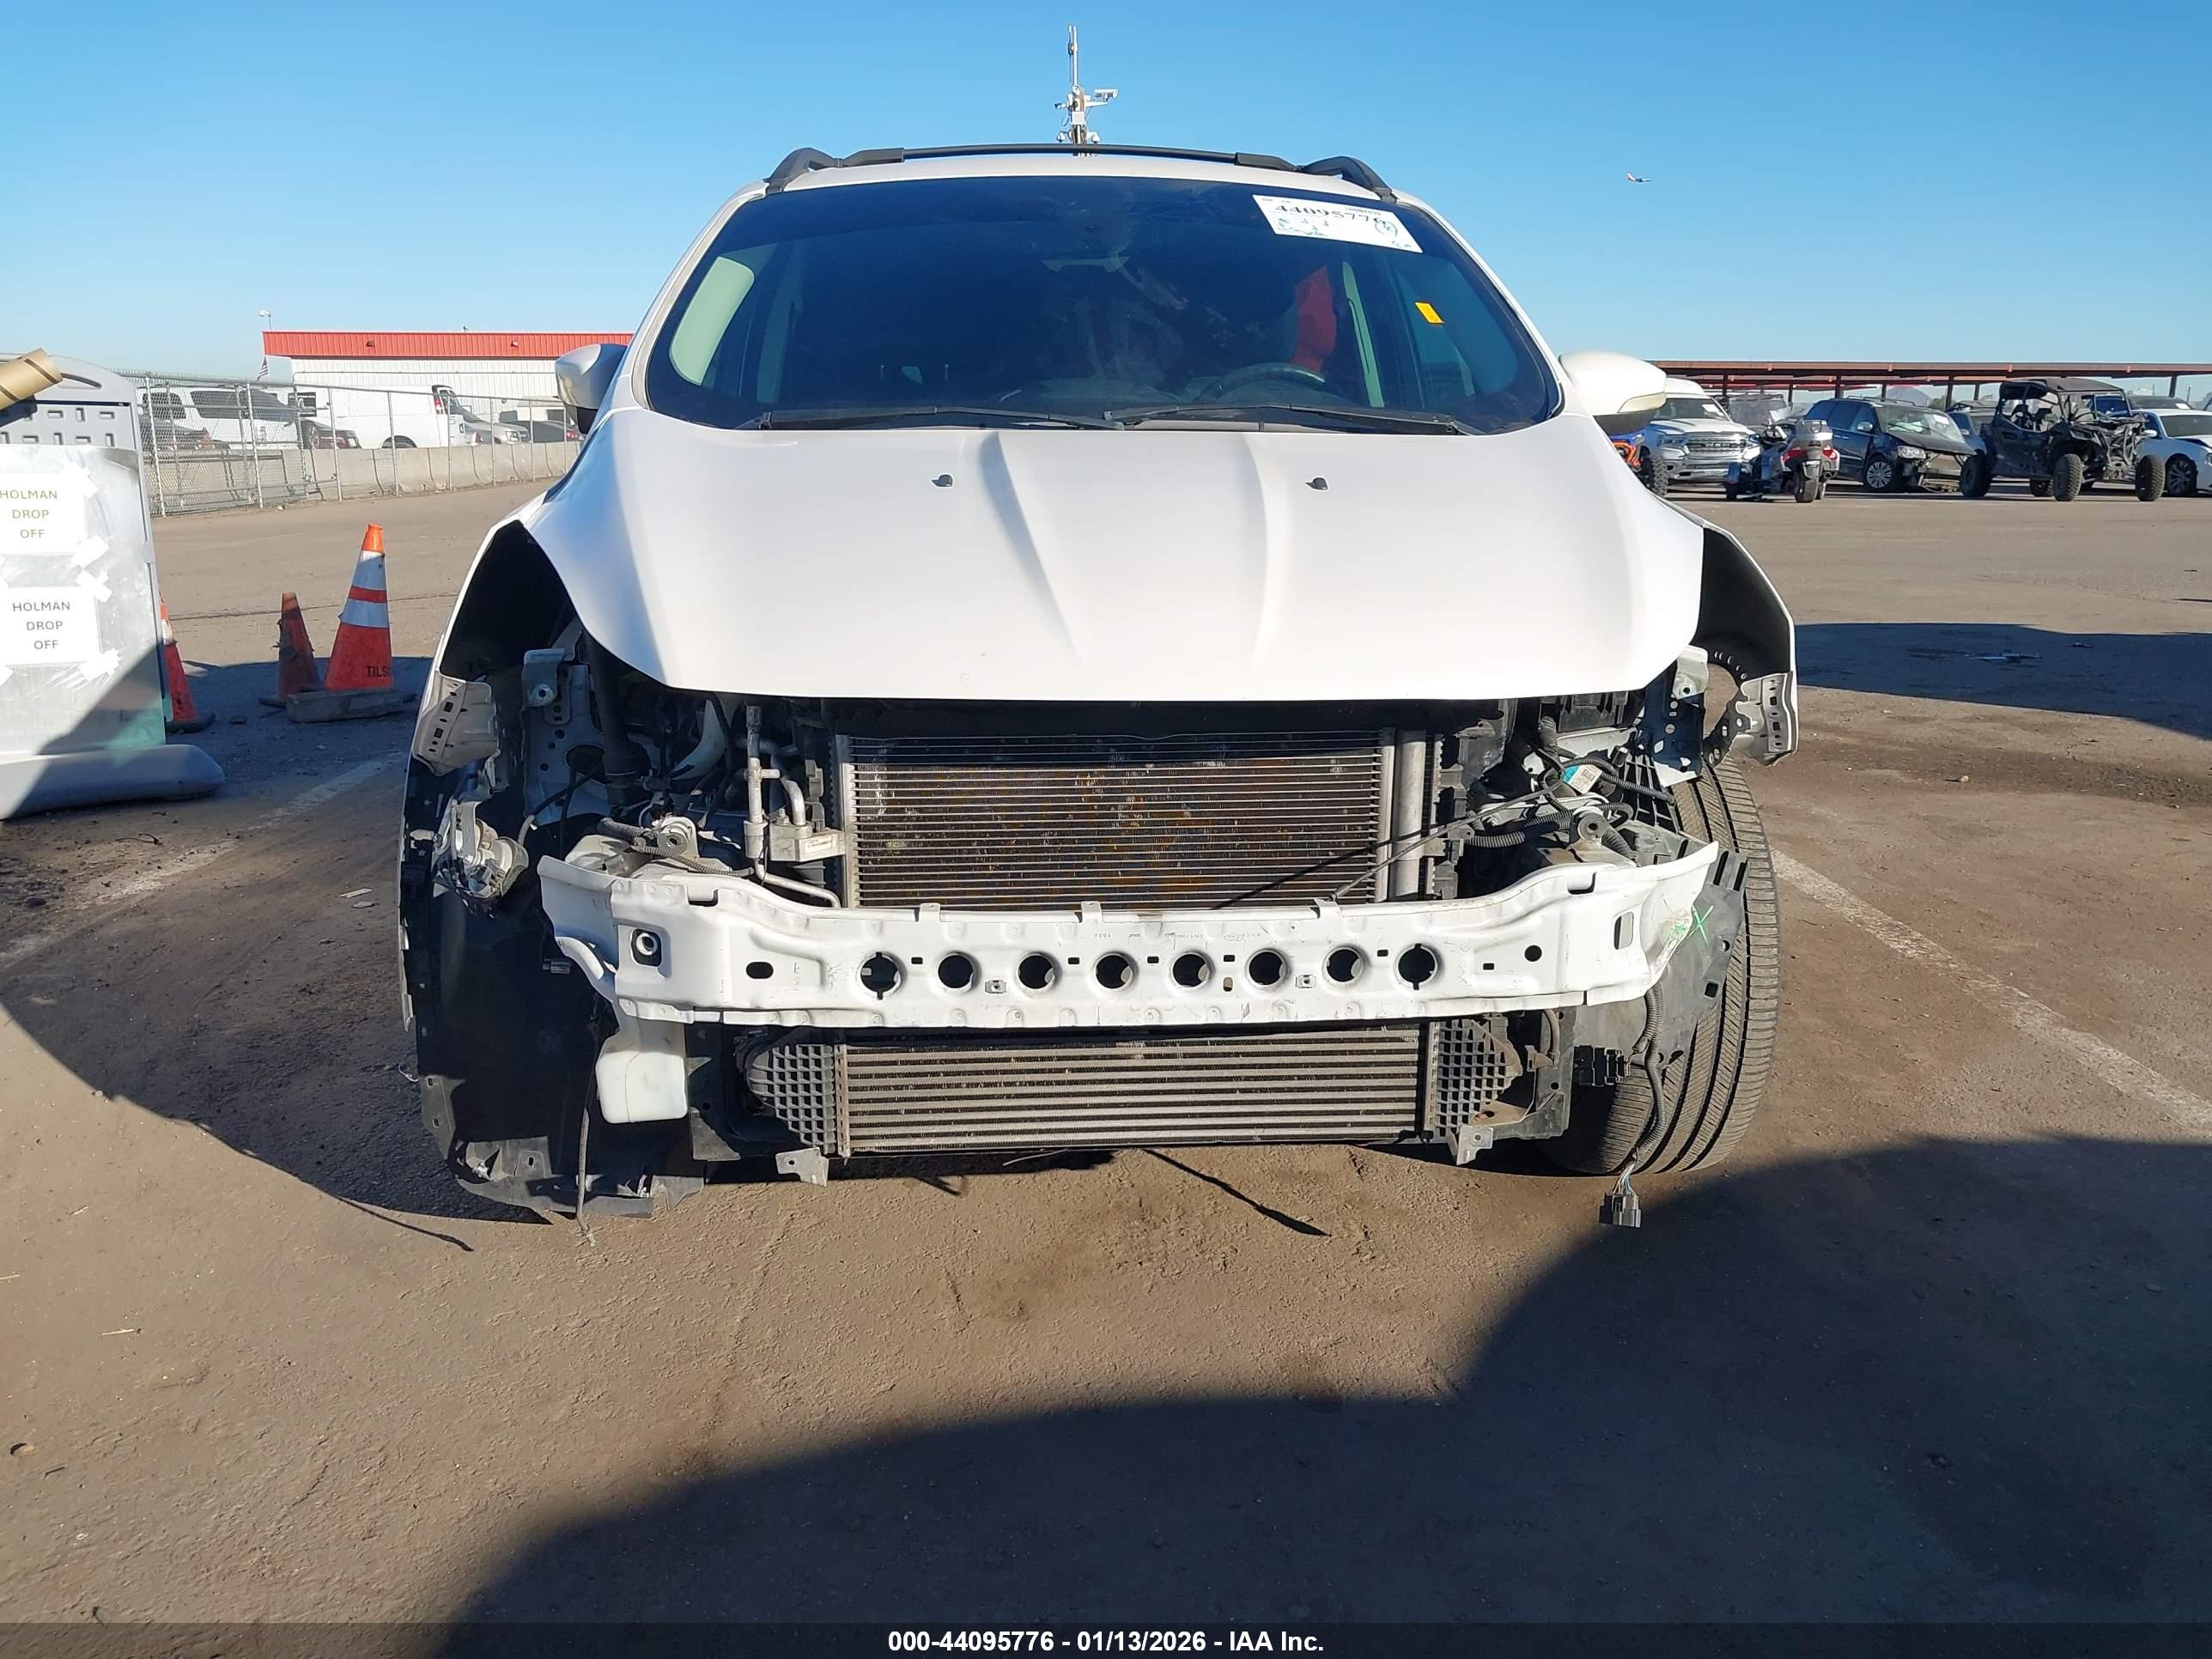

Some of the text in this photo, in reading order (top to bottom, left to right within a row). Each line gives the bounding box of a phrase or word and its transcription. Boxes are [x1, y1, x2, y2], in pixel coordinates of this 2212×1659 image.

[0, 489, 58, 500] HOLMAN
[12, 509, 49, 519] DROP
[20, 529, 46, 538] OFF
[12, 601, 70, 611] HOLMAN
[26, 620, 63, 630] DROP
[33, 640, 58, 650] OFF
